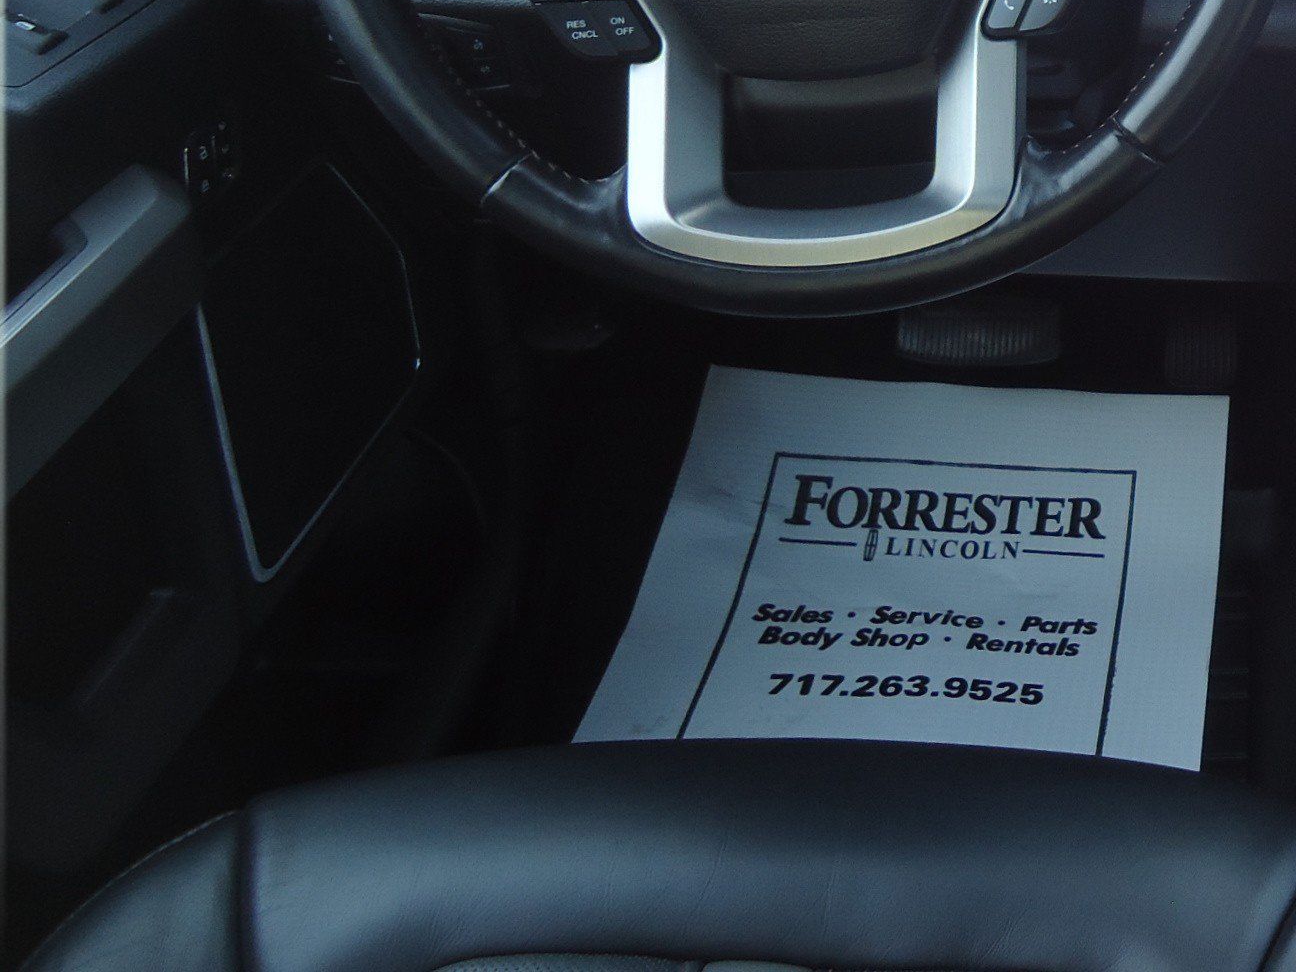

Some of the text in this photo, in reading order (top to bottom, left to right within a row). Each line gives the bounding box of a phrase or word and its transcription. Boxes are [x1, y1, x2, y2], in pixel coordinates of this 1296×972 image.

[566, 20, 586, 29] RES
[610, 17, 625, 25] ON
[615, 27, 634, 36] OFF
[572, 30, 598, 40] CNCL
[784, 474, 1106, 540] FORRESTER
[885, 536, 1021, 559] LINCOLN
[752, 603, 1098, 635] Sales Service Parts
[758, 626, 1080, 657] Body Shop Rentals
[769, 673, 1044, 705] 717.263.9525
